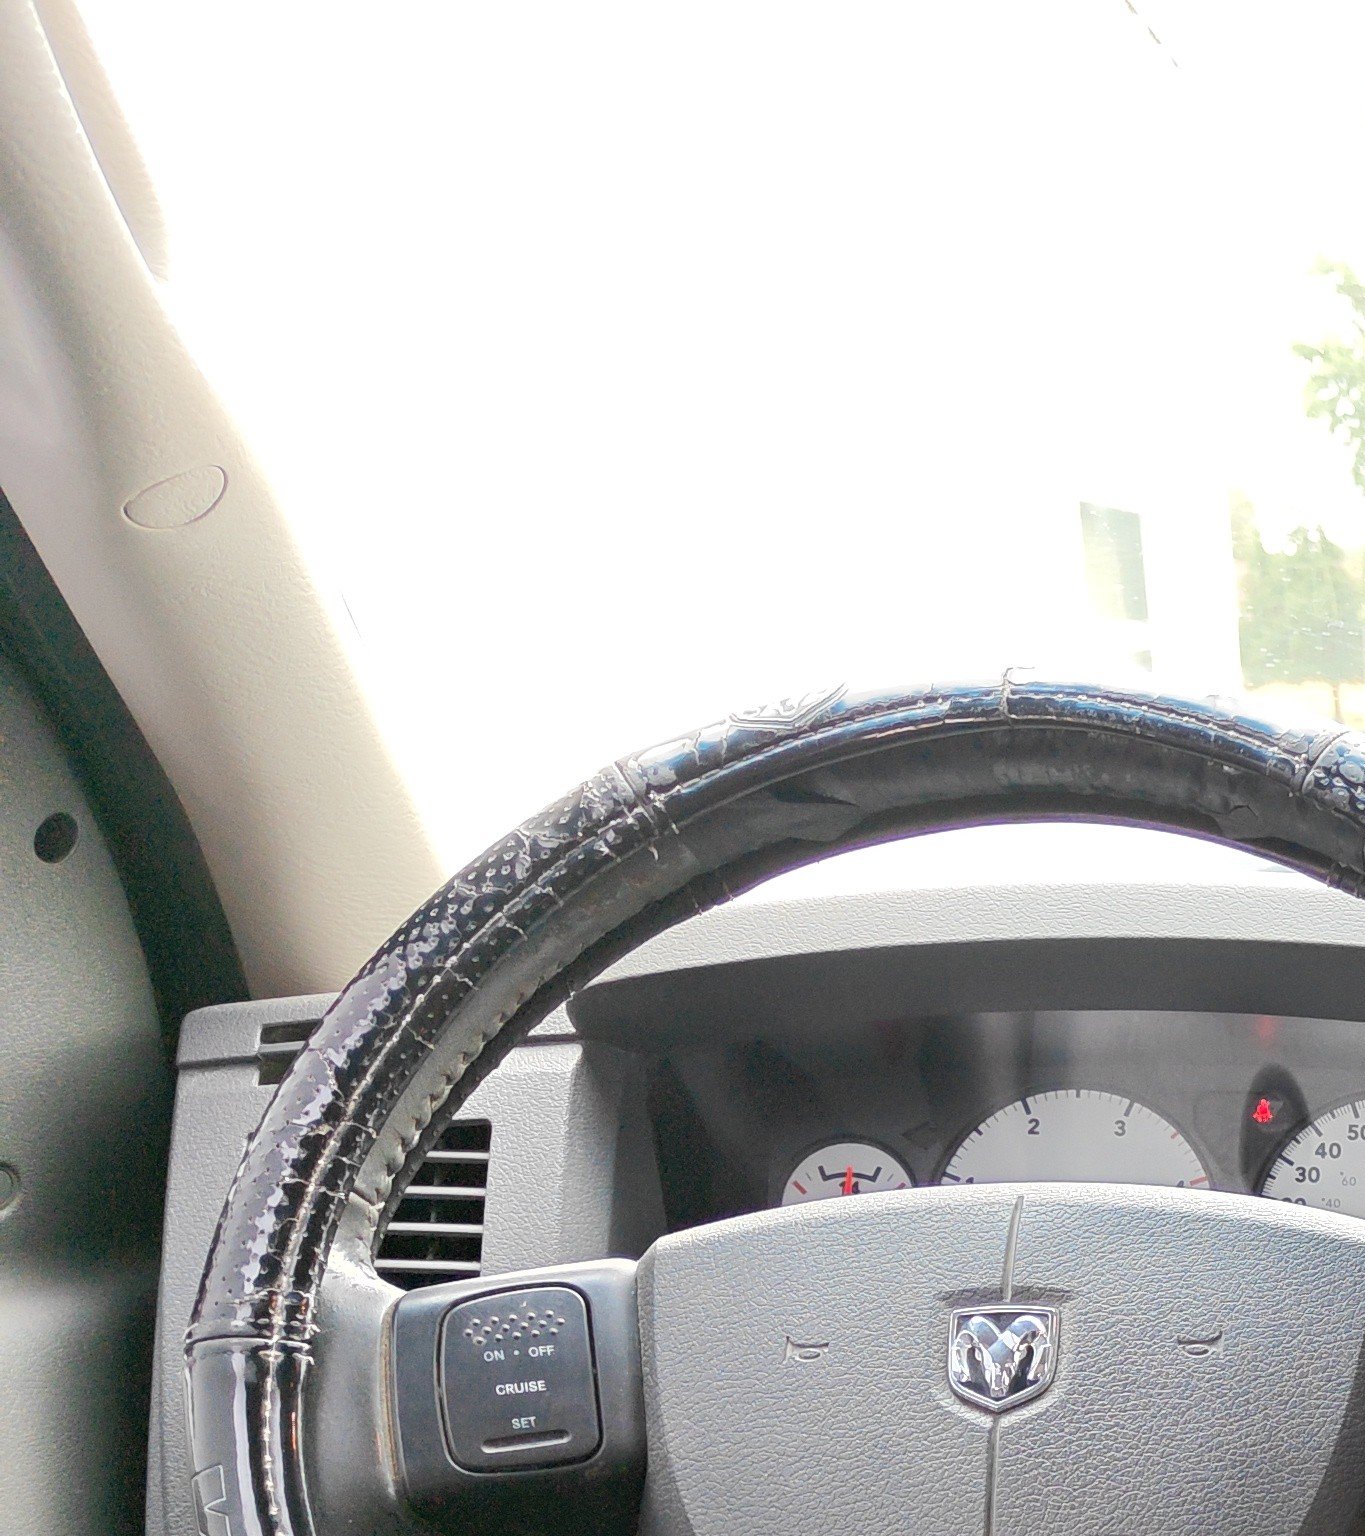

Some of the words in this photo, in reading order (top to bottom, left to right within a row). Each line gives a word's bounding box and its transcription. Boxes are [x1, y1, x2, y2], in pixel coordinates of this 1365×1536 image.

[1027, 1118, 1040, 1135] 2
[1114, 1119, 1126, 1137] 3
[1314, 1142, 1342, 1159] 40
[1294, 1166, 1321, 1183] 30
[1341, 1176, 1357, 1187] 60
[1325, 1198, 1341, 1208] 40
[483, 1349, 506, 1362] ON
[528, 1344, 555, 1357] OFF
[495, 1380, 547, 1396] CRUISE
[511, 1416, 537, 1429] SET
